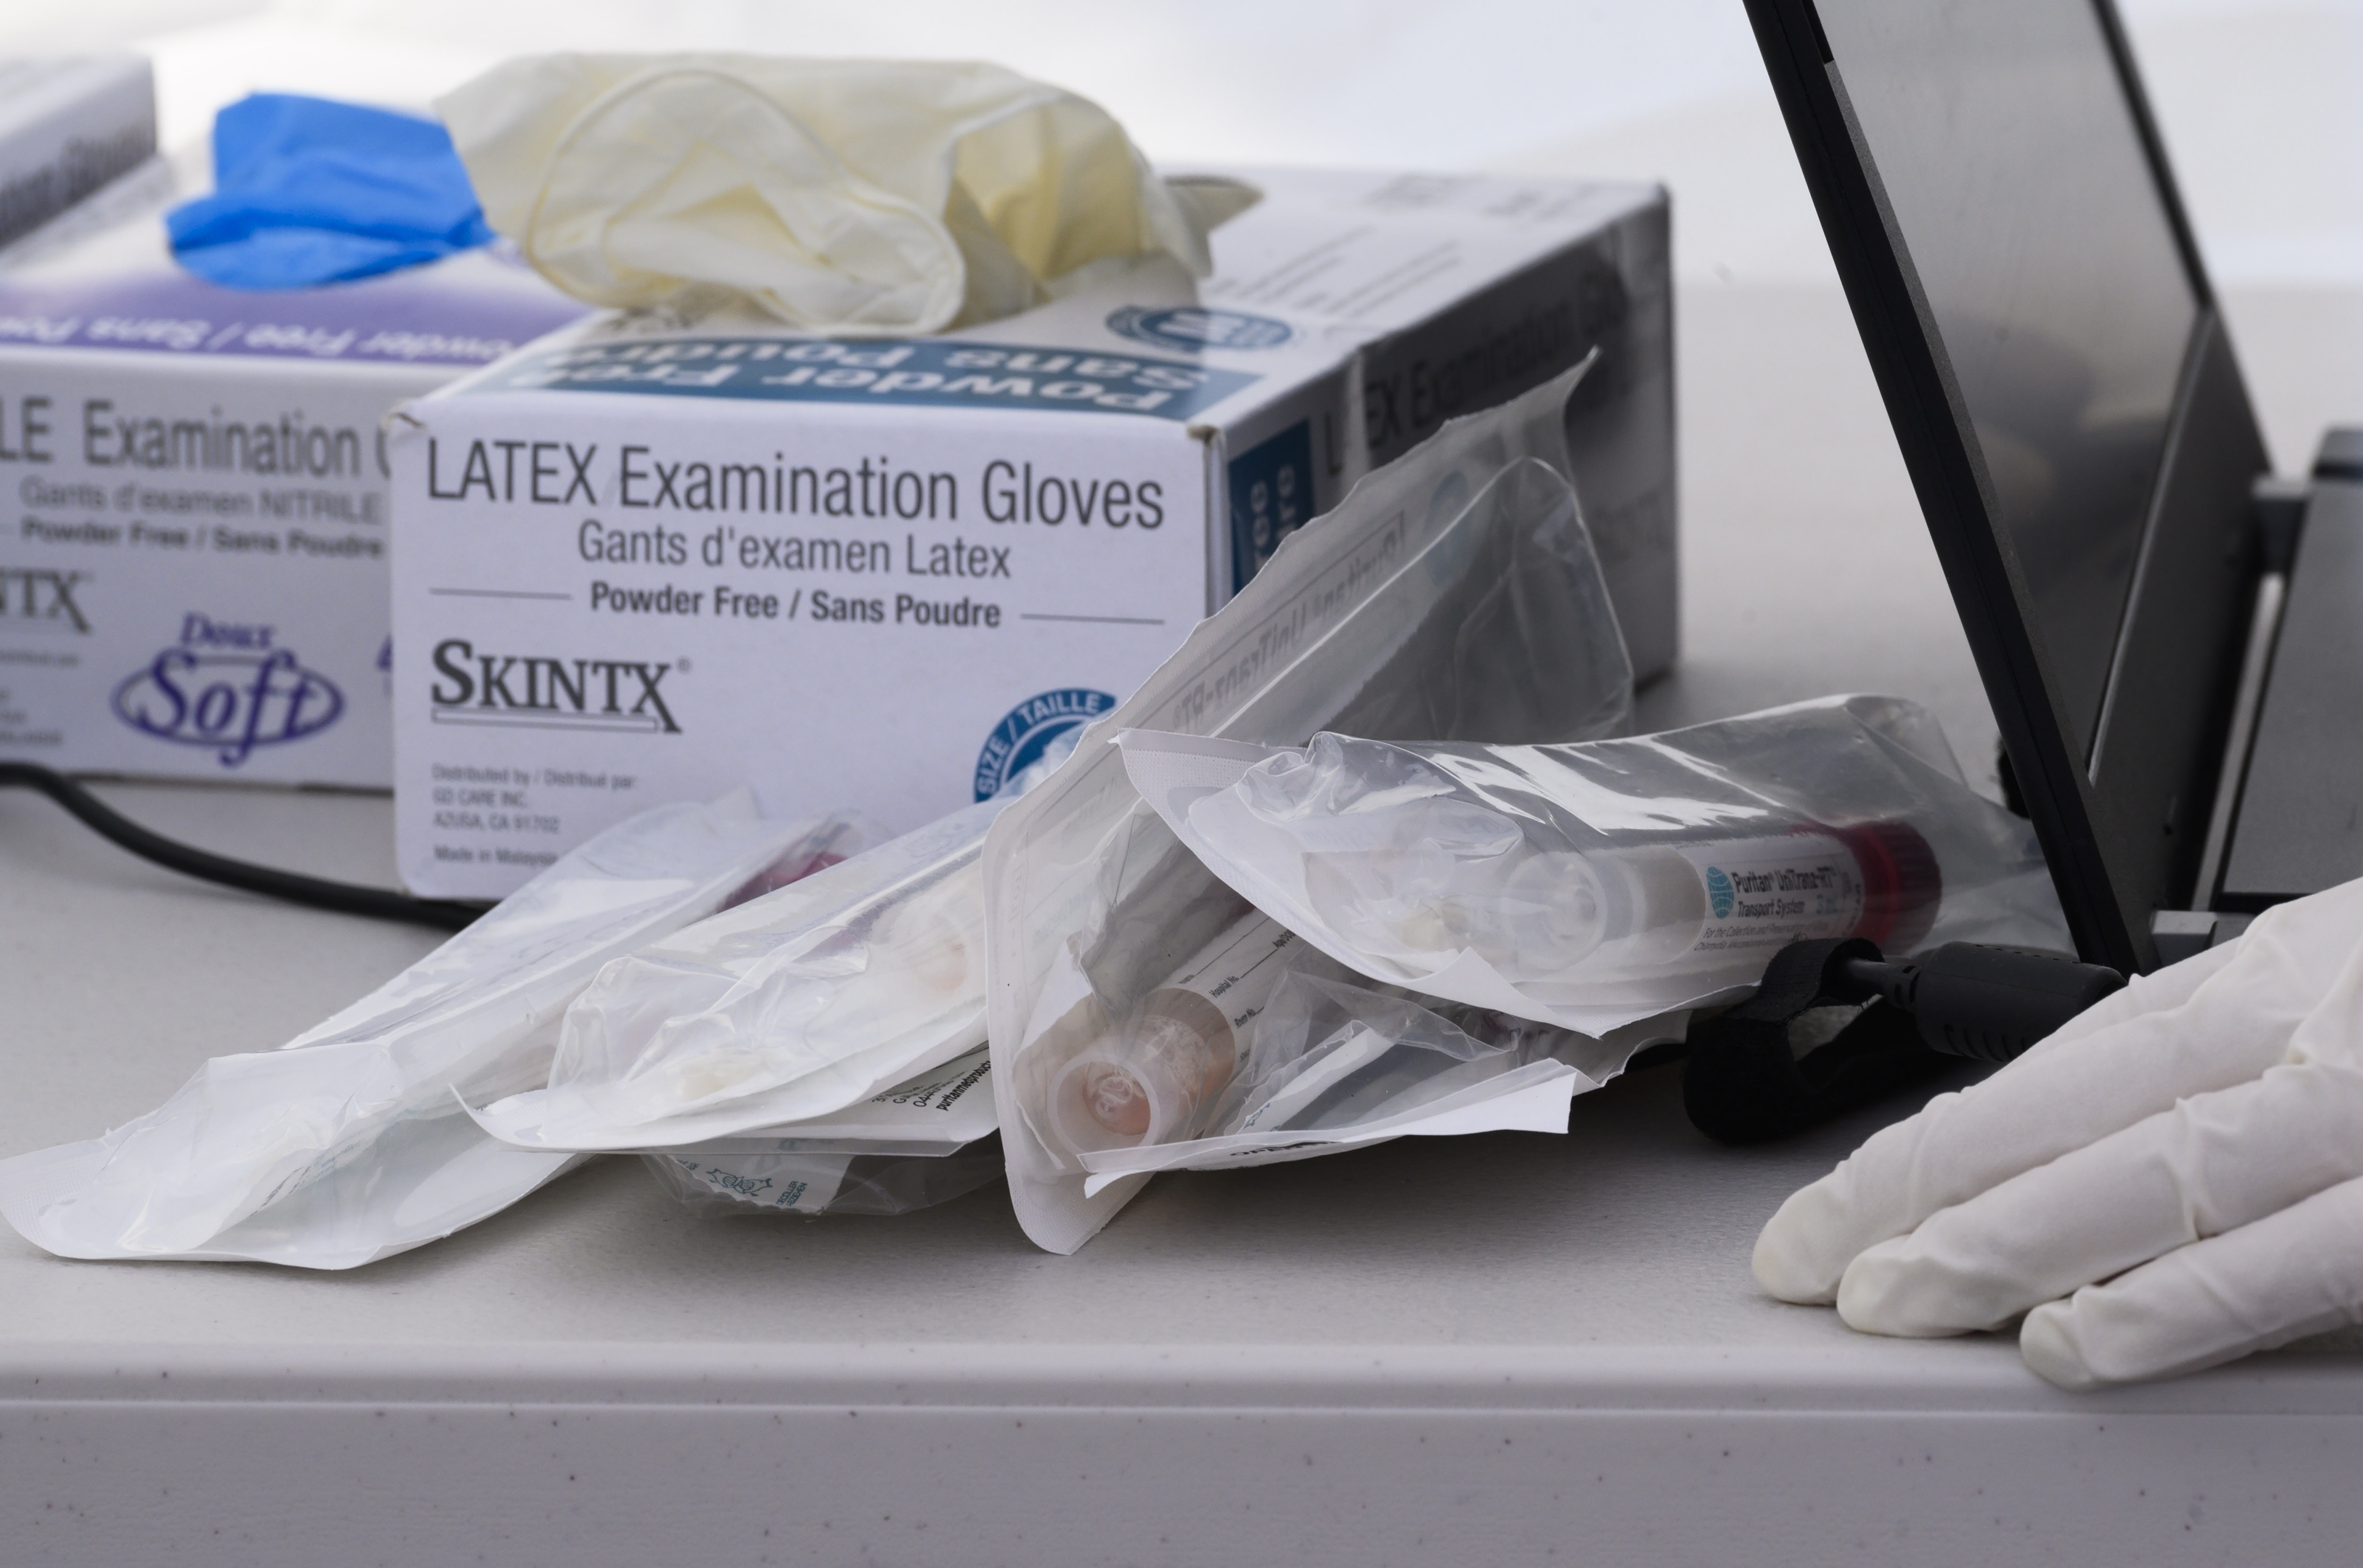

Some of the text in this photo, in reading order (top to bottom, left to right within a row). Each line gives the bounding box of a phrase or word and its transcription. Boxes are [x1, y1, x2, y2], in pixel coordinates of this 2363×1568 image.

[362, 330, 516, 359] owder
[762, 364, 1175, 411] Powder
[947, 349, 1209, 389] Sans
[83, 398, 362, 477] Examination
[20, 474, 384, 526] Gants d'examen NITRILE
[427, 437, 599, 506] LATEX
[621, 444, 957, 521] Examination
[982, 459, 1164, 530] Gloves
[21, 515, 121, 546] Powder
[129, 520, 189, 550] Free
[212, 524, 280, 556] Sans
[578, 518, 1011, 579] Gants d'examen Latex
[591, 580, 1001, 628] Powder Free / Sans Poudre
[134, 646, 318, 768] Soft
[976, 691, 1101, 795] SIZE / TAILLE
[1738, 898, 1805, 920] Transport System
[1208, 978, 1232, 999] Hospital
